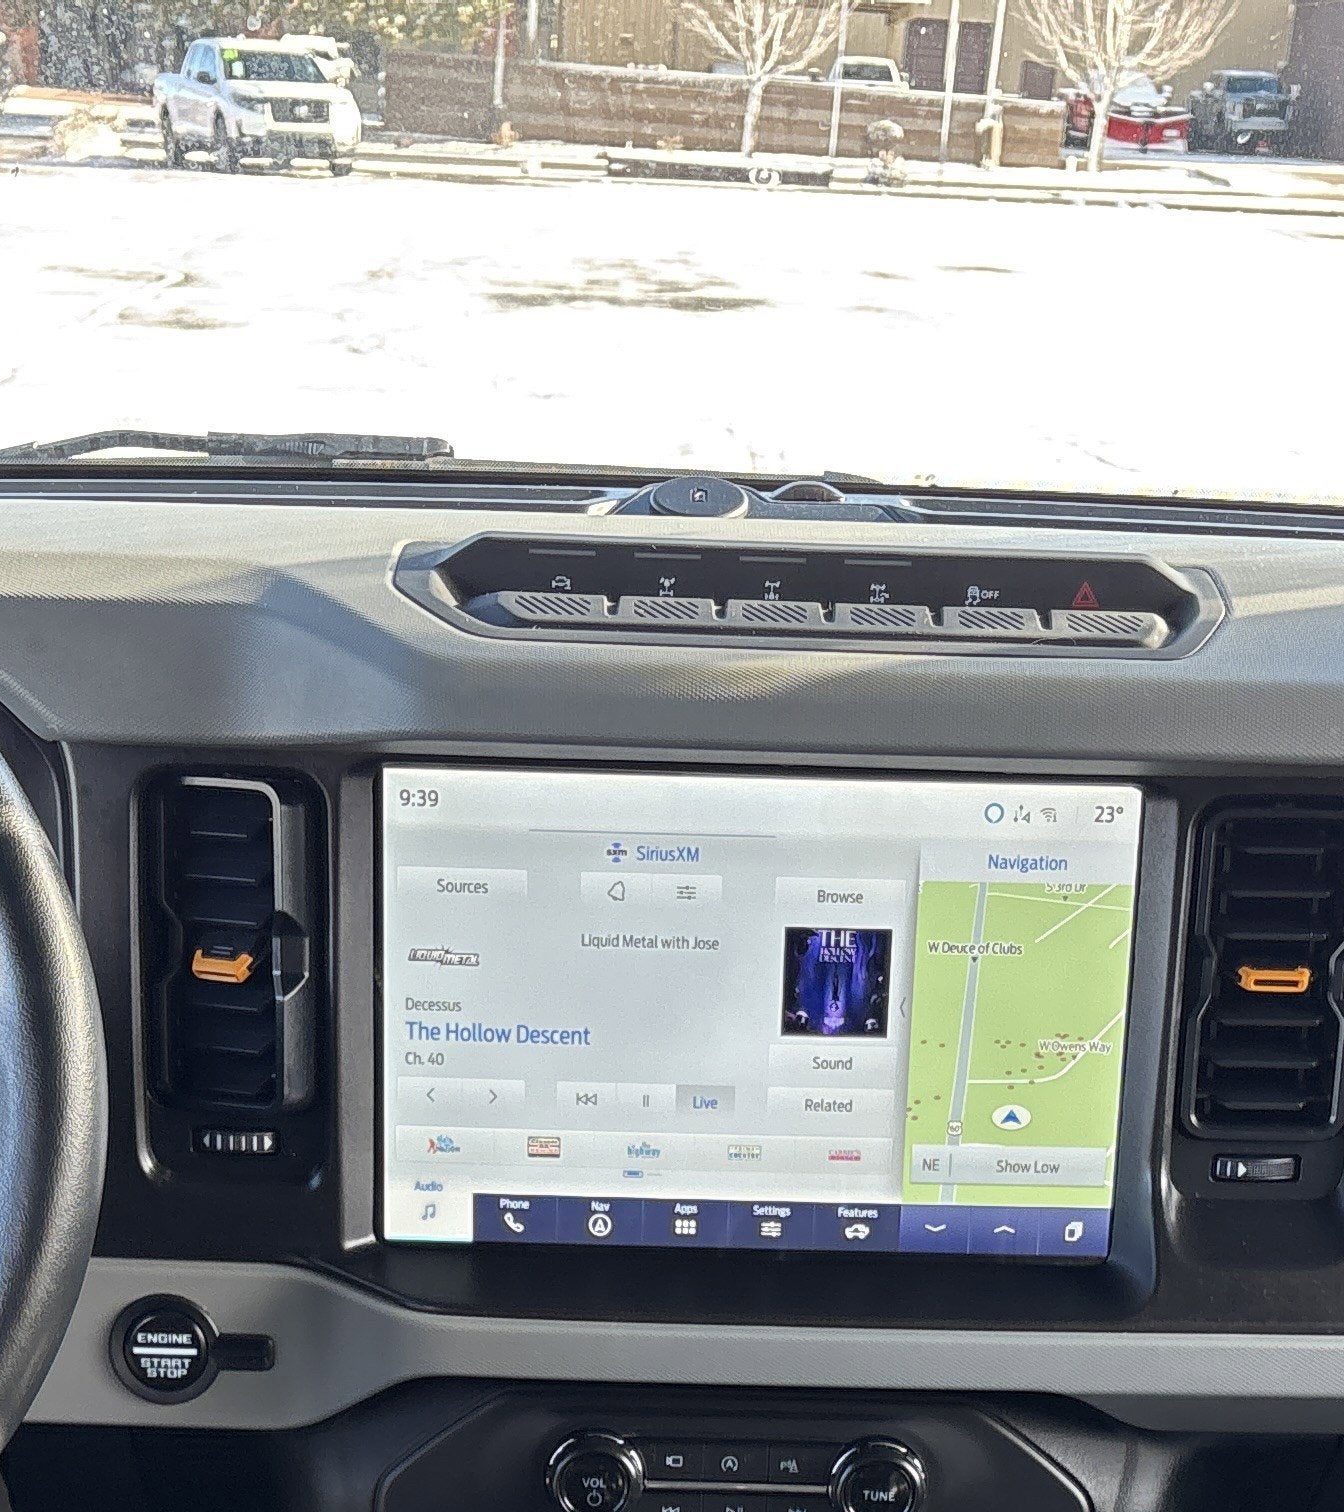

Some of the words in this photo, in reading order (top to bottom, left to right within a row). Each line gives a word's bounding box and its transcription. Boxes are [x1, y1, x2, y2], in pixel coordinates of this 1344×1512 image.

[981, 590, 1000, 600] OFF
[399, 788, 440, 807] 9:39
[636, 845, 700, 863] SiriusXM
[987, 854, 1069, 874] Navigation
[436, 878, 489, 894] Sources
[816, 889, 864, 905] Browse
[581, 933, 619, 949] Liquid
[622, 934, 658, 949] Metal
[660, 936, 690, 950] with
[694, 937, 720, 951] Jose
[818, 930, 857, 947] THE
[928, 942, 941, 953] W
[942, 942, 976, 954] Deuce
[978, 942, 990, 954] of
[991, 943, 1023, 955] Clubs
[406, 997, 462, 1012] Decessus
[405, 1021, 441, 1041] The
[445, 1023, 511, 1043] Hollow
[516, 1024, 591, 1046] Descent
[1039, 1041, 1050, 1051] W
[1052, 1041, 1086, 1052] Owens
[1089, 1042, 1111, 1053] Way
[405, 1051, 425, 1066] Ch.
[427, 1052, 445, 1066] 40
[812, 1055, 854, 1071] Sound
[692, 1095, 719, 1109] Live
[804, 1098, 854, 1113] Related
[921, 1158, 940, 1172] NE
[996, 1160, 1031, 1174] Show
[1034, 1160, 1061, 1174] Low
[414, 1180, 444, 1192] Audio
[499, 1198, 530, 1210] Phone
[591, 1200, 610, 1211] Nav
[674, 1203, 698, 1215] Apps
[752, 1204, 791, 1218] Settings
[837, 1206, 879, 1219] Features
[137, 1332, 193, 1345] ENGINE
[140, 1357, 192, 1369] START
[146, 1367, 188, 1379] STOP
[582, 1477, 606, 1489] VOL
[863, 1489, 895, 1502] TUNE
